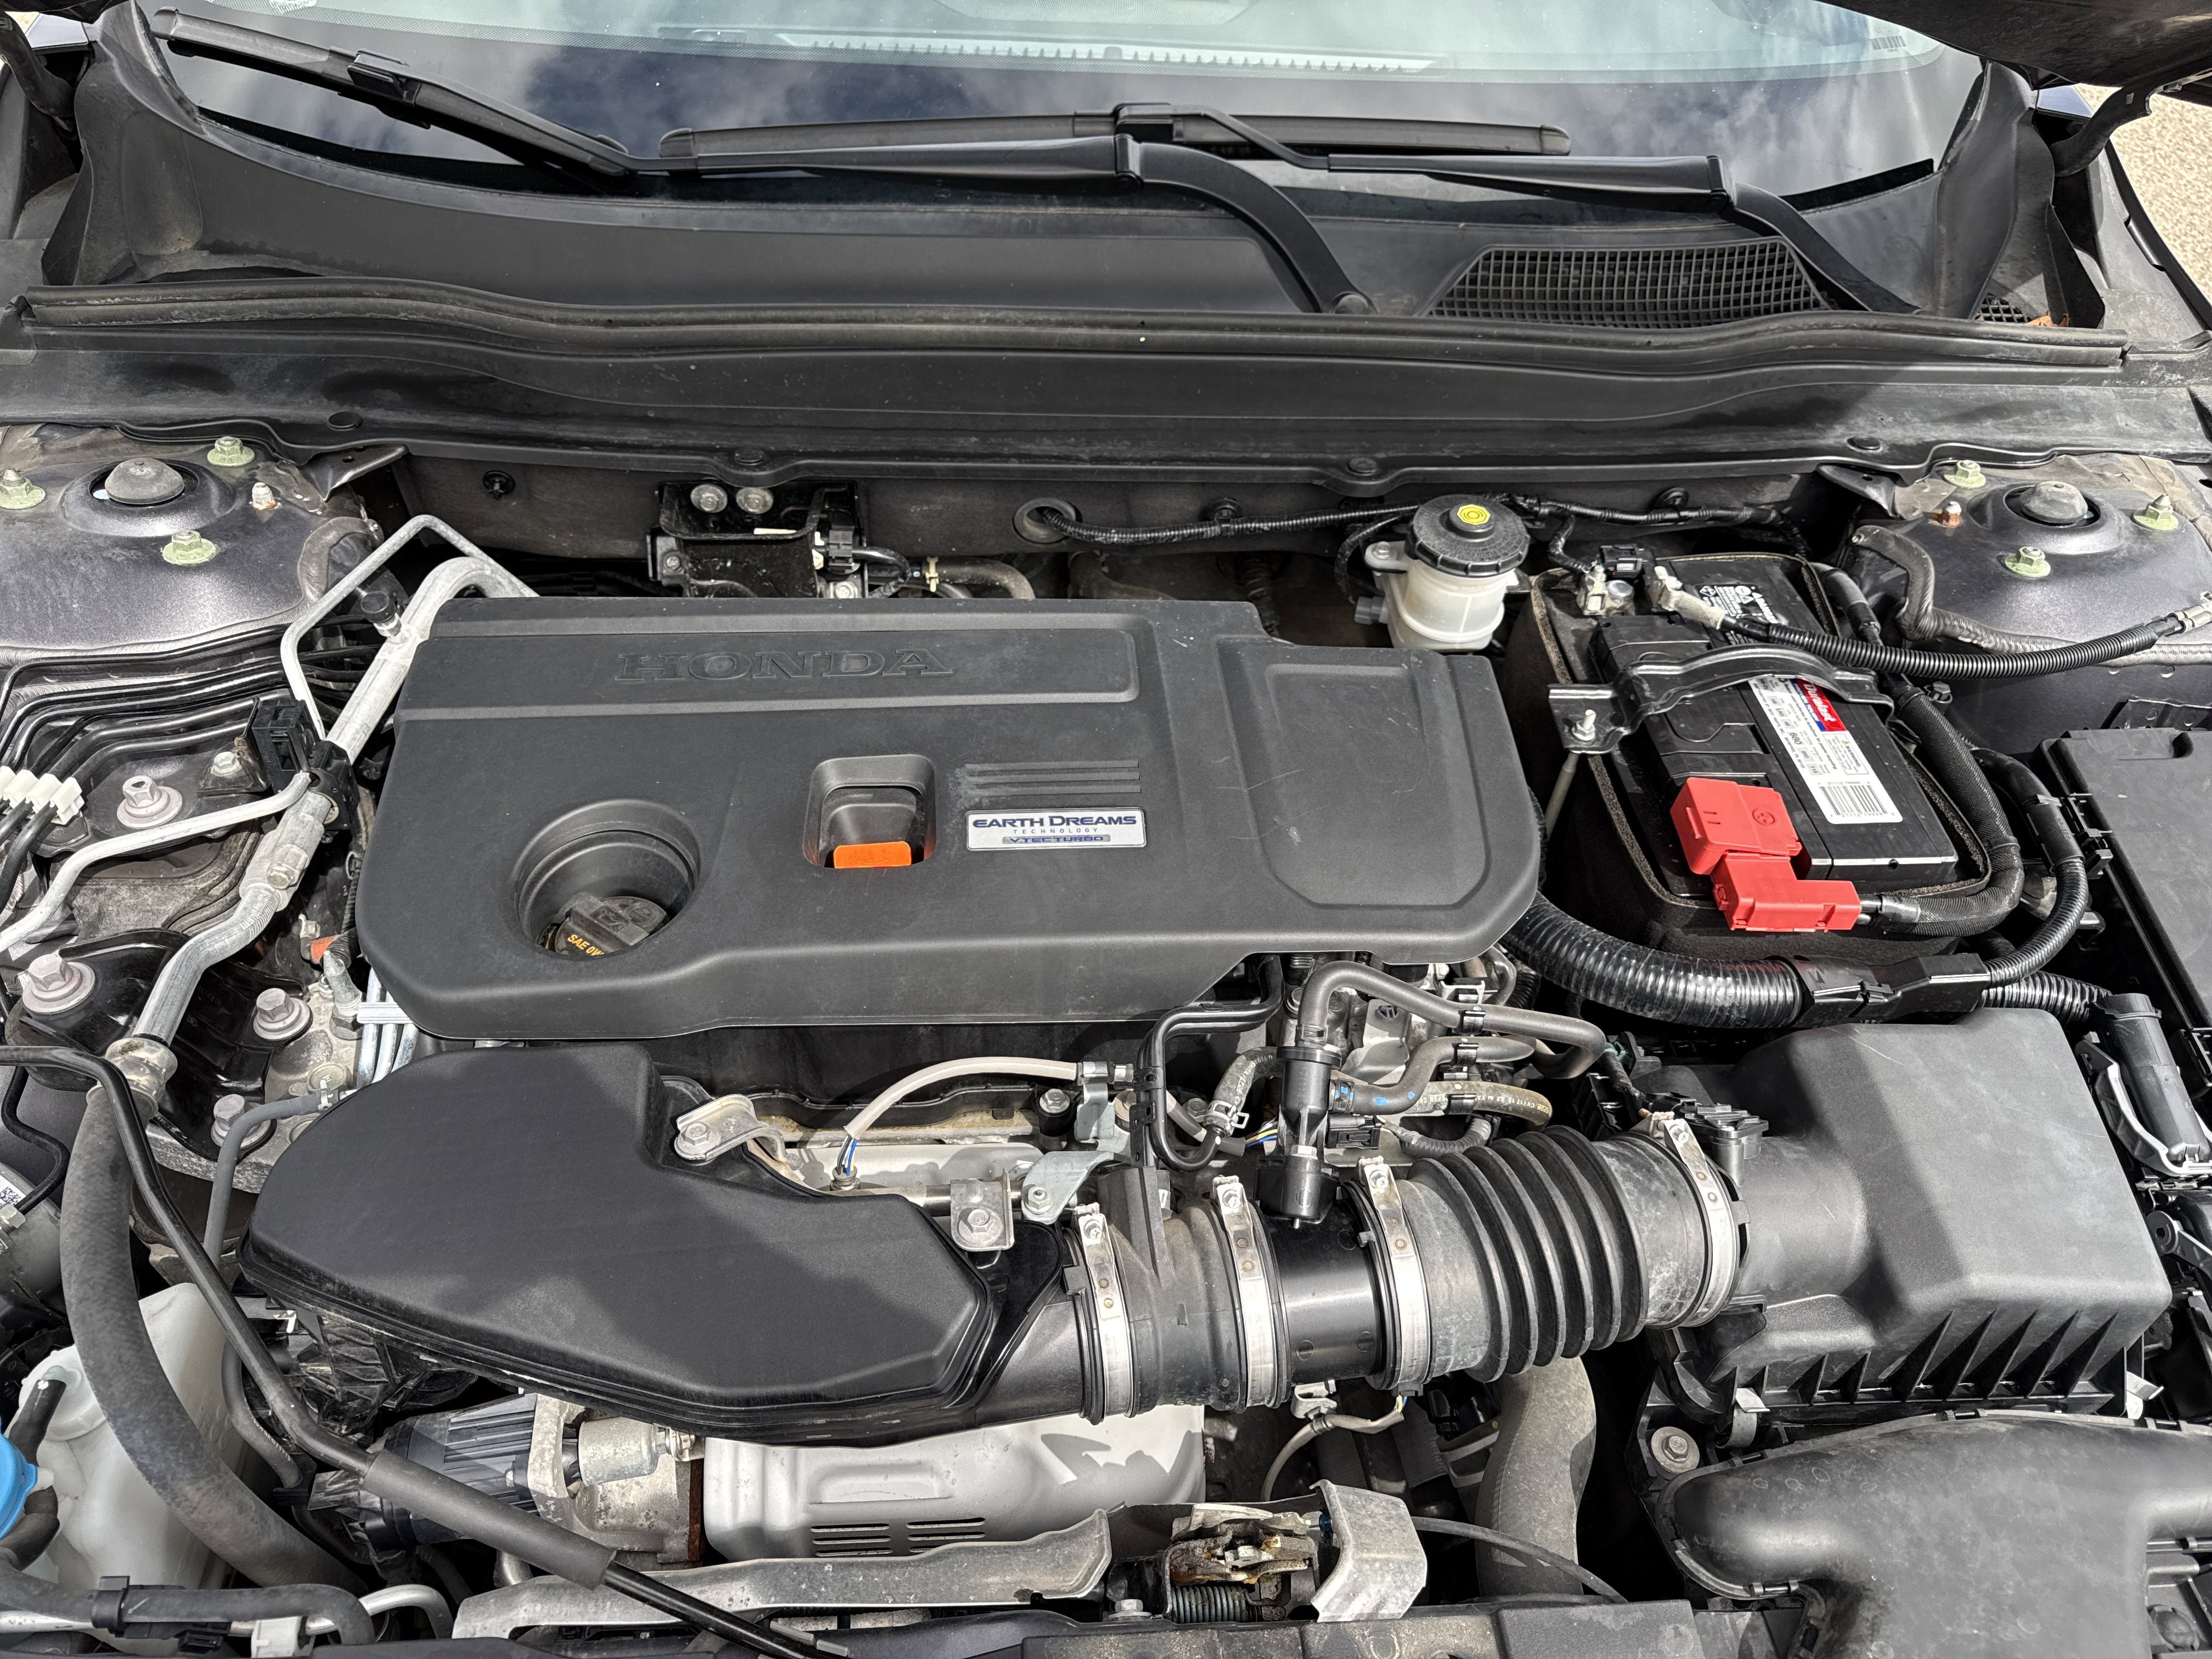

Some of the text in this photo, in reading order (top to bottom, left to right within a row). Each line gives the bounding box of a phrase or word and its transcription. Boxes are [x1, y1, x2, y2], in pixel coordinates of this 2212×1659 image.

[613, 648, 953, 681] HONDA
[1803, 684, 1837, 723] Duralast
[1788, 732, 1803, 744] 680
[973, 815, 1137, 827] EARTH DREAMS
[567, 934, 590, 950] SAE
